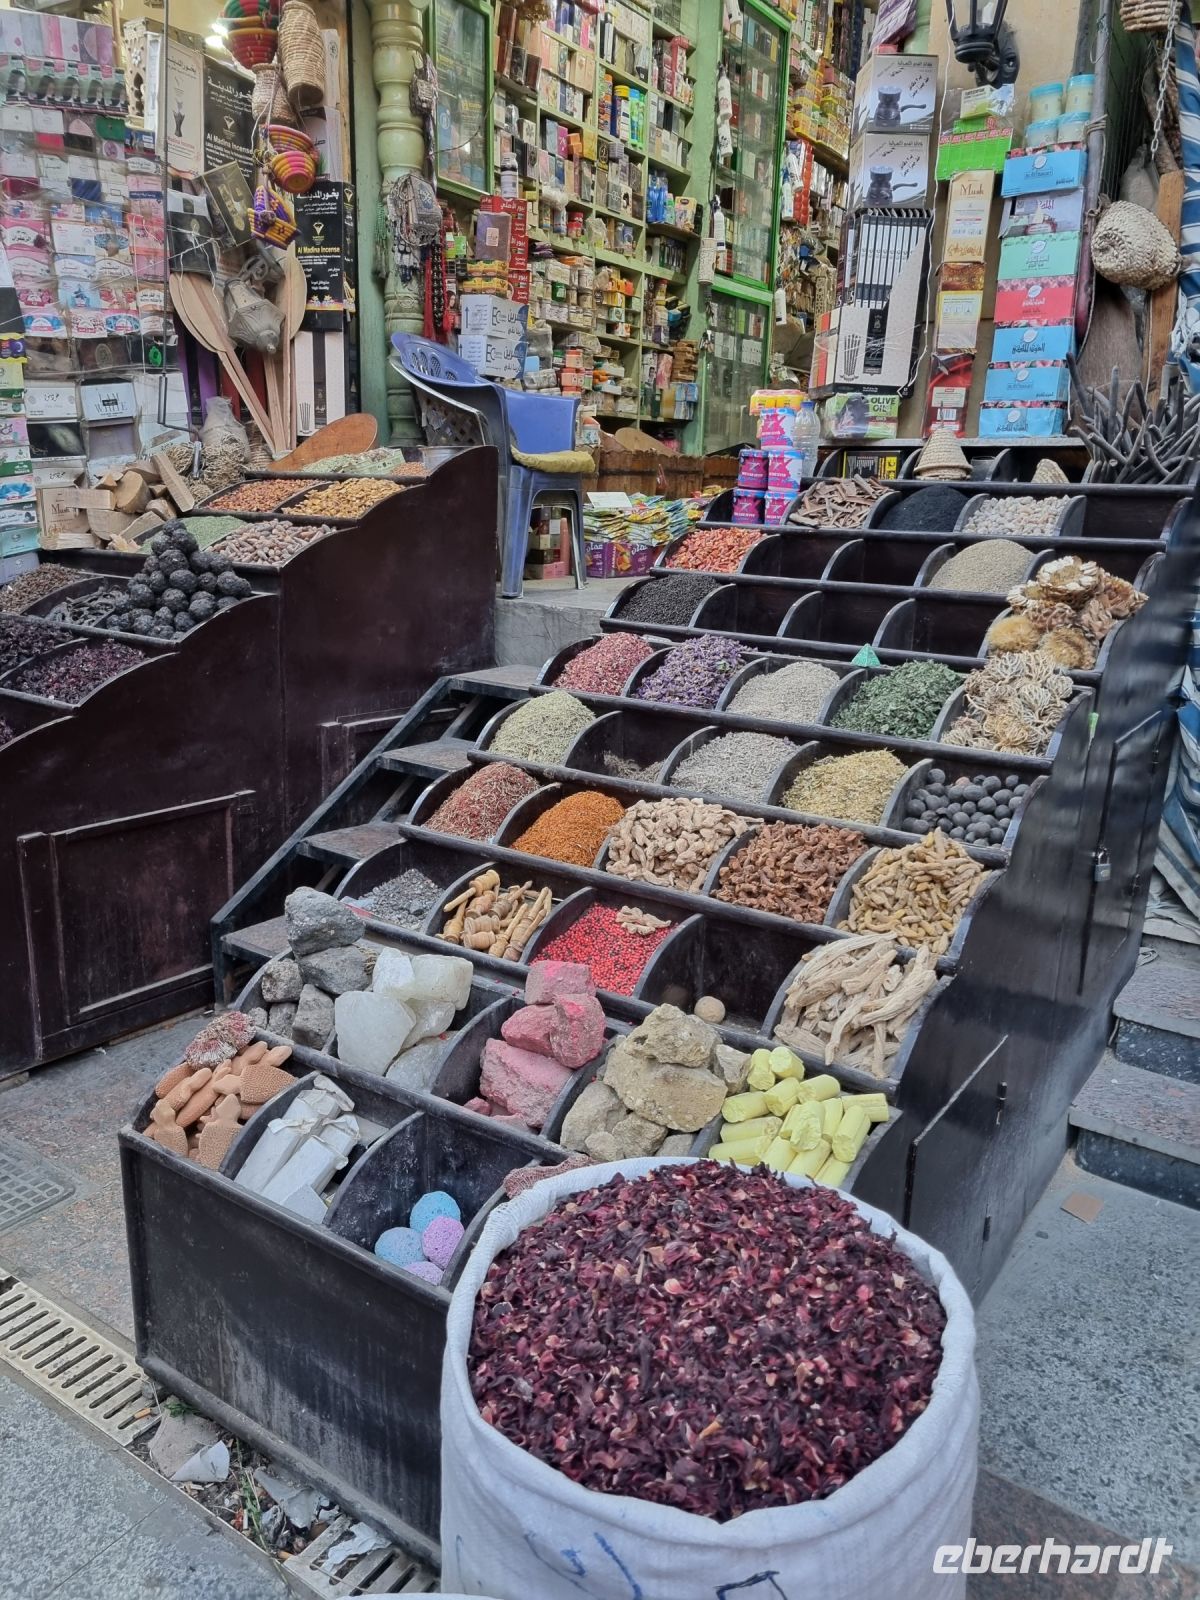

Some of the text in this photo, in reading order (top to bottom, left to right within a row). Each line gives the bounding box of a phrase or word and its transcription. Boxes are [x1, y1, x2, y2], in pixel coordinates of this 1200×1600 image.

[959, 183, 984, 196] Musk
[303, 246, 320, 254] Madina
[870, 397, 896, 405] OLIVE
[872, 404, 887, 413] OIL
